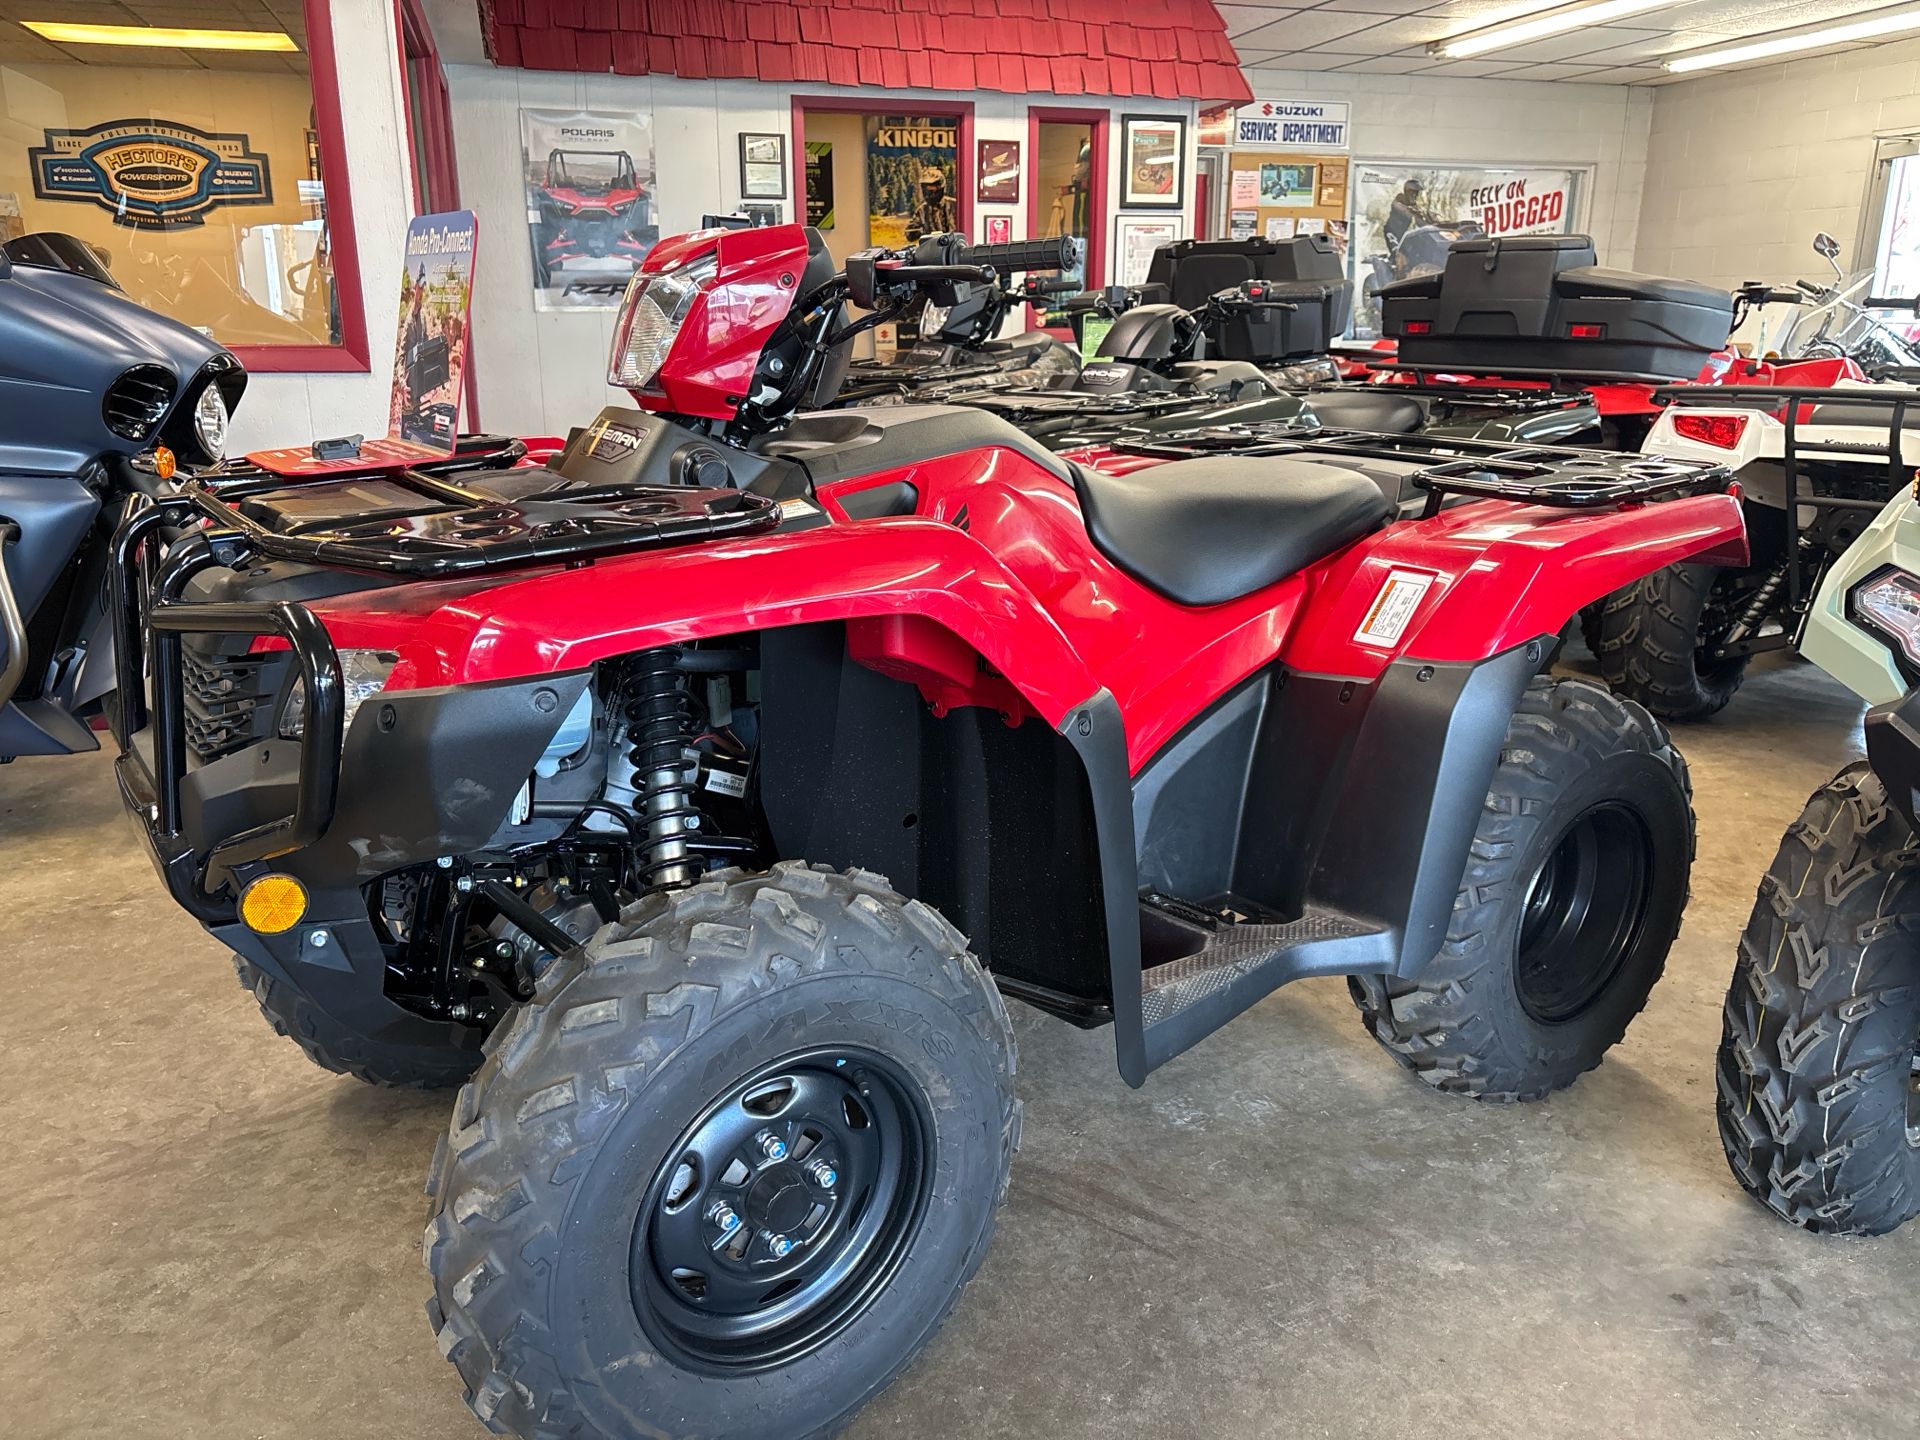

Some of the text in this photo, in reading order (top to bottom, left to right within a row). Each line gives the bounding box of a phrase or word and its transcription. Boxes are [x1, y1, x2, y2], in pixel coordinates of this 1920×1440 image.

[1275, 106, 1323, 117] SUZUKI
[136, 127, 196, 141] THROTTLE
[561, 128, 615, 138] POLARIS
[1240, 120, 1343, 144] SERVICE DEPARTMENT
[104, 148, 198, 173] HECTOR'S
[119, 173, 188, 182] POWERSPORTS
[1470, 178, 1528, 207] RELY ON
[1470, 208, 1483, 218] THE
[1484, 190, 1564, 236] RUGGED
[407, 225, 474, 256] Honda Pro-Connect
[701, 999, 957, 1080] MAXXIS
